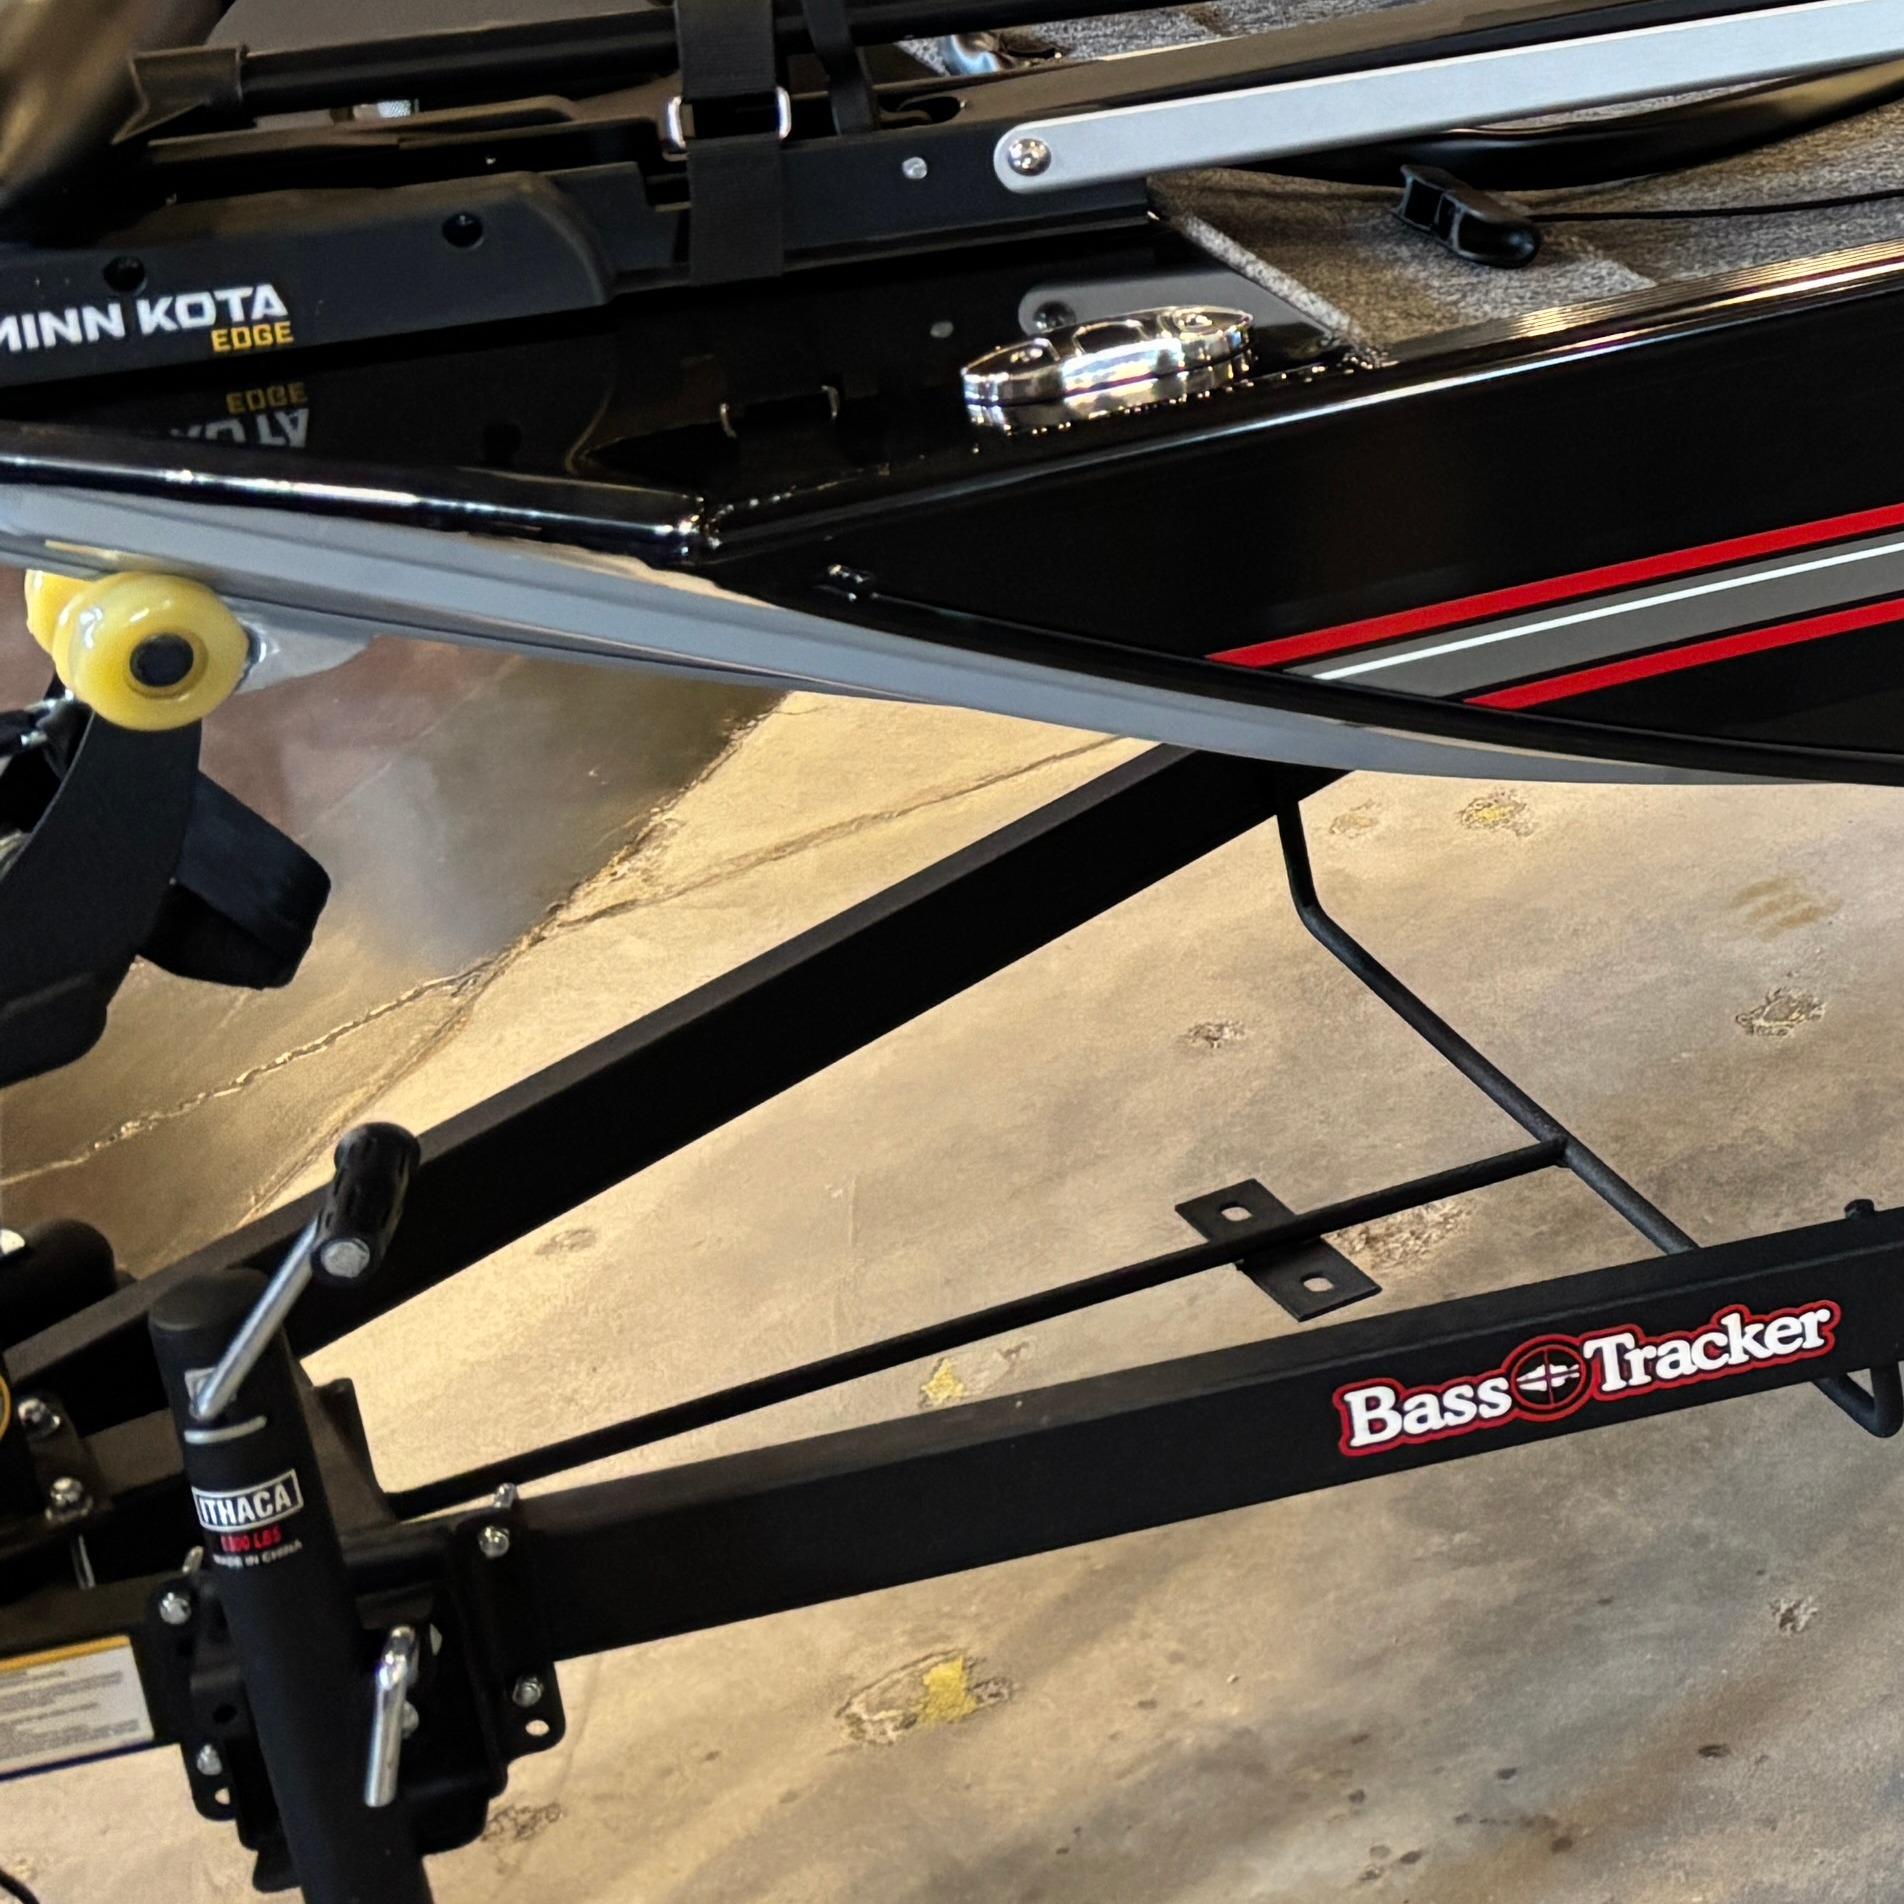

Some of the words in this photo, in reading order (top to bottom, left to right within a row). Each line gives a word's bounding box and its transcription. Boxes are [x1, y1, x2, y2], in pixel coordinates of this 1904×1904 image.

[136, 283, 289, 336] KOTA
[211, 320, 295, 353] EDGE
[1341, 1374, 1511, 1449] Bass
[1582, 1306, 1832, 1394] Tracker
[200, 1483, 292, 1526] ITHACA
